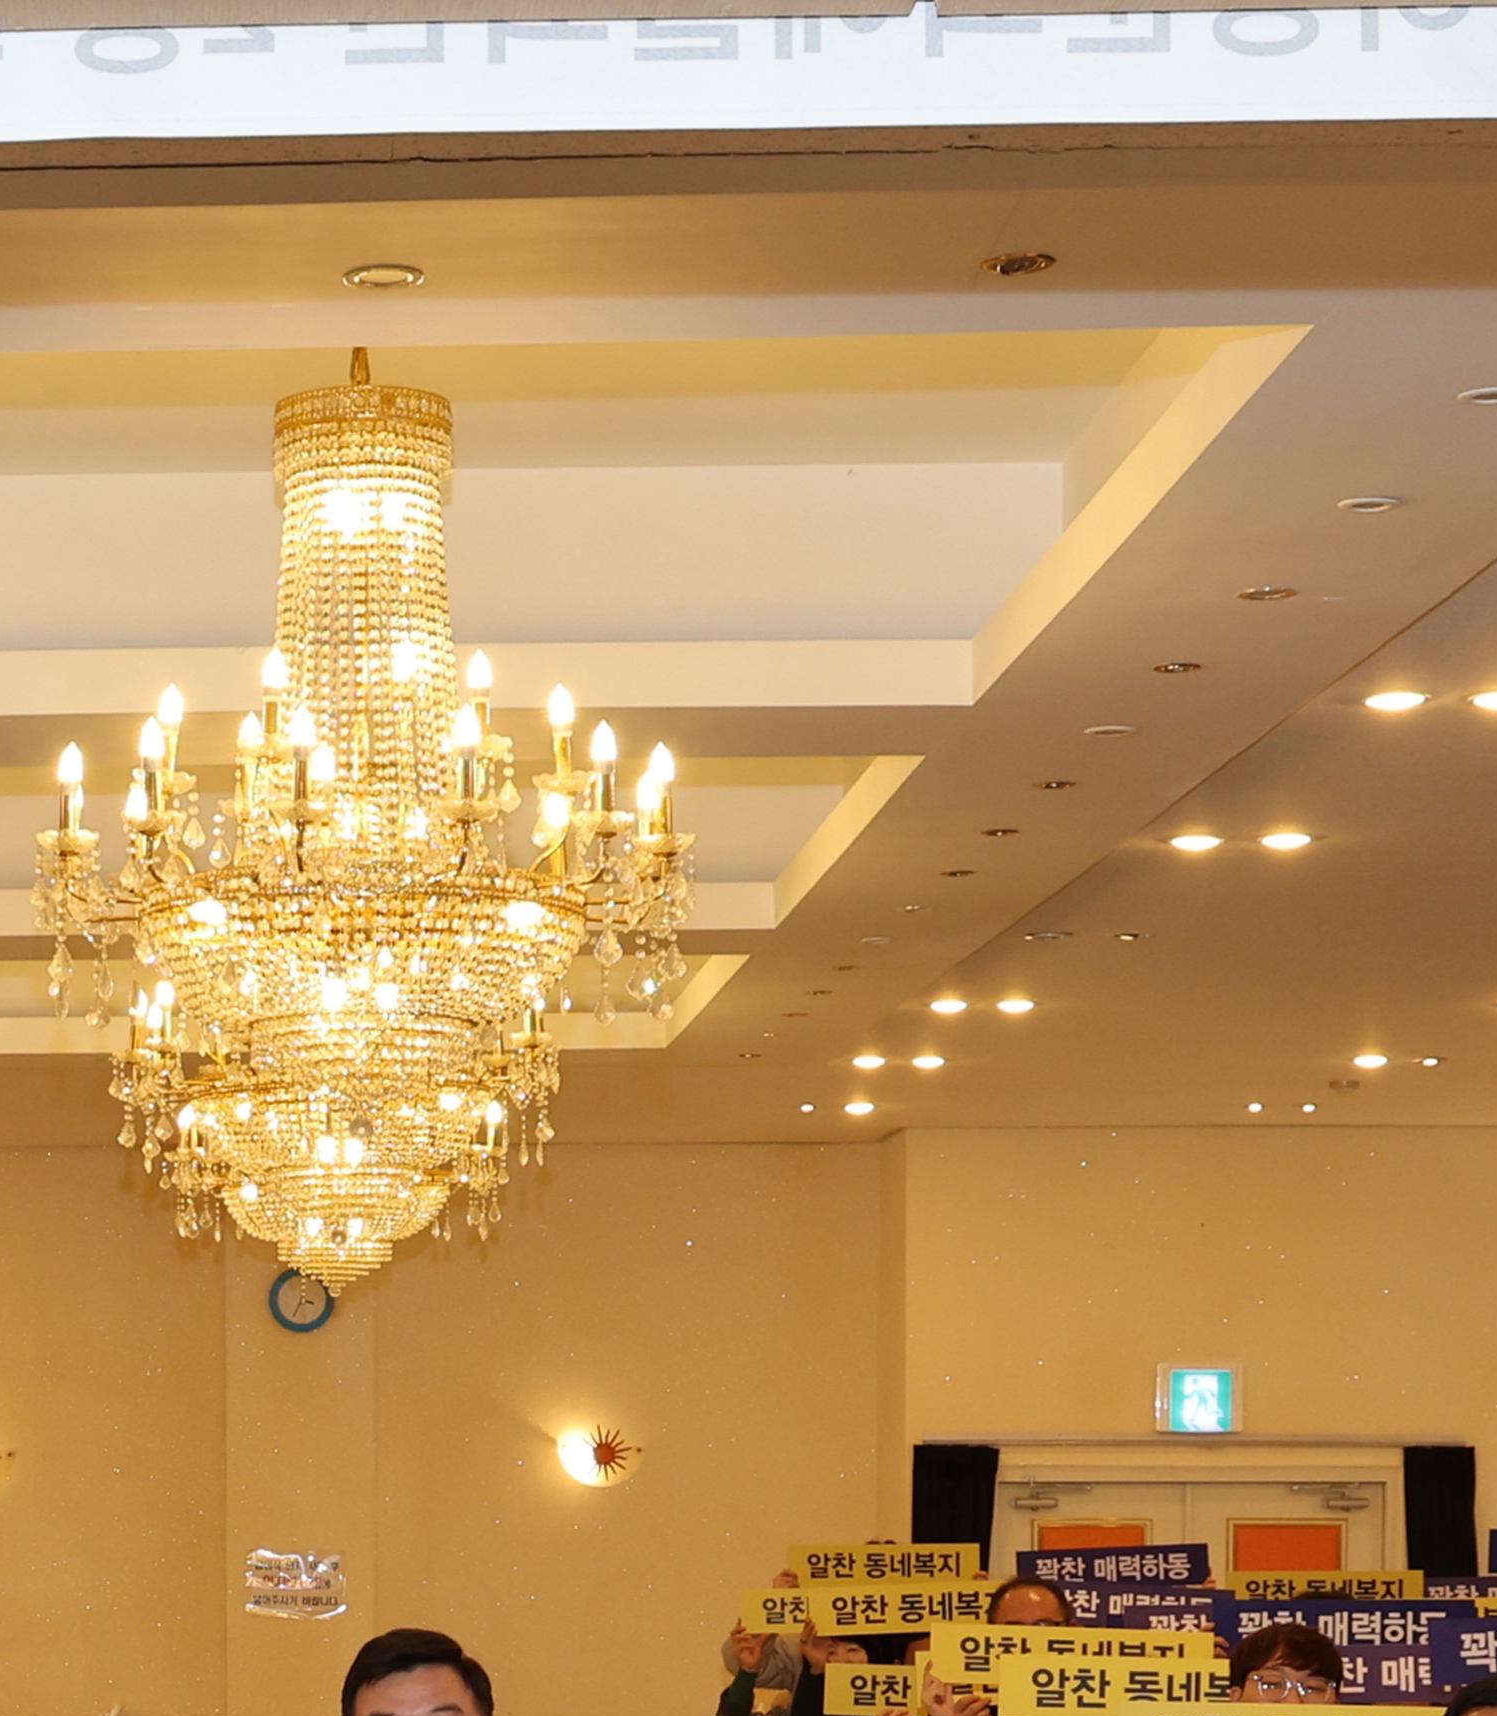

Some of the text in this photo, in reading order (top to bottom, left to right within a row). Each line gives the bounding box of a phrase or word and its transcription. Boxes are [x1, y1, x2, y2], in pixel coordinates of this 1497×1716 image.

[806, 1552, 961, 1579] 알찬 동네복지
[1035, 1552, 1192, 1584] 꽉찬 매력하동
[831, 1590, 990, 1626] 알찬 동네복
[849, 1675, 912, 1707] 알찬
[1031, 1667, 1111, 1709] 알찬
